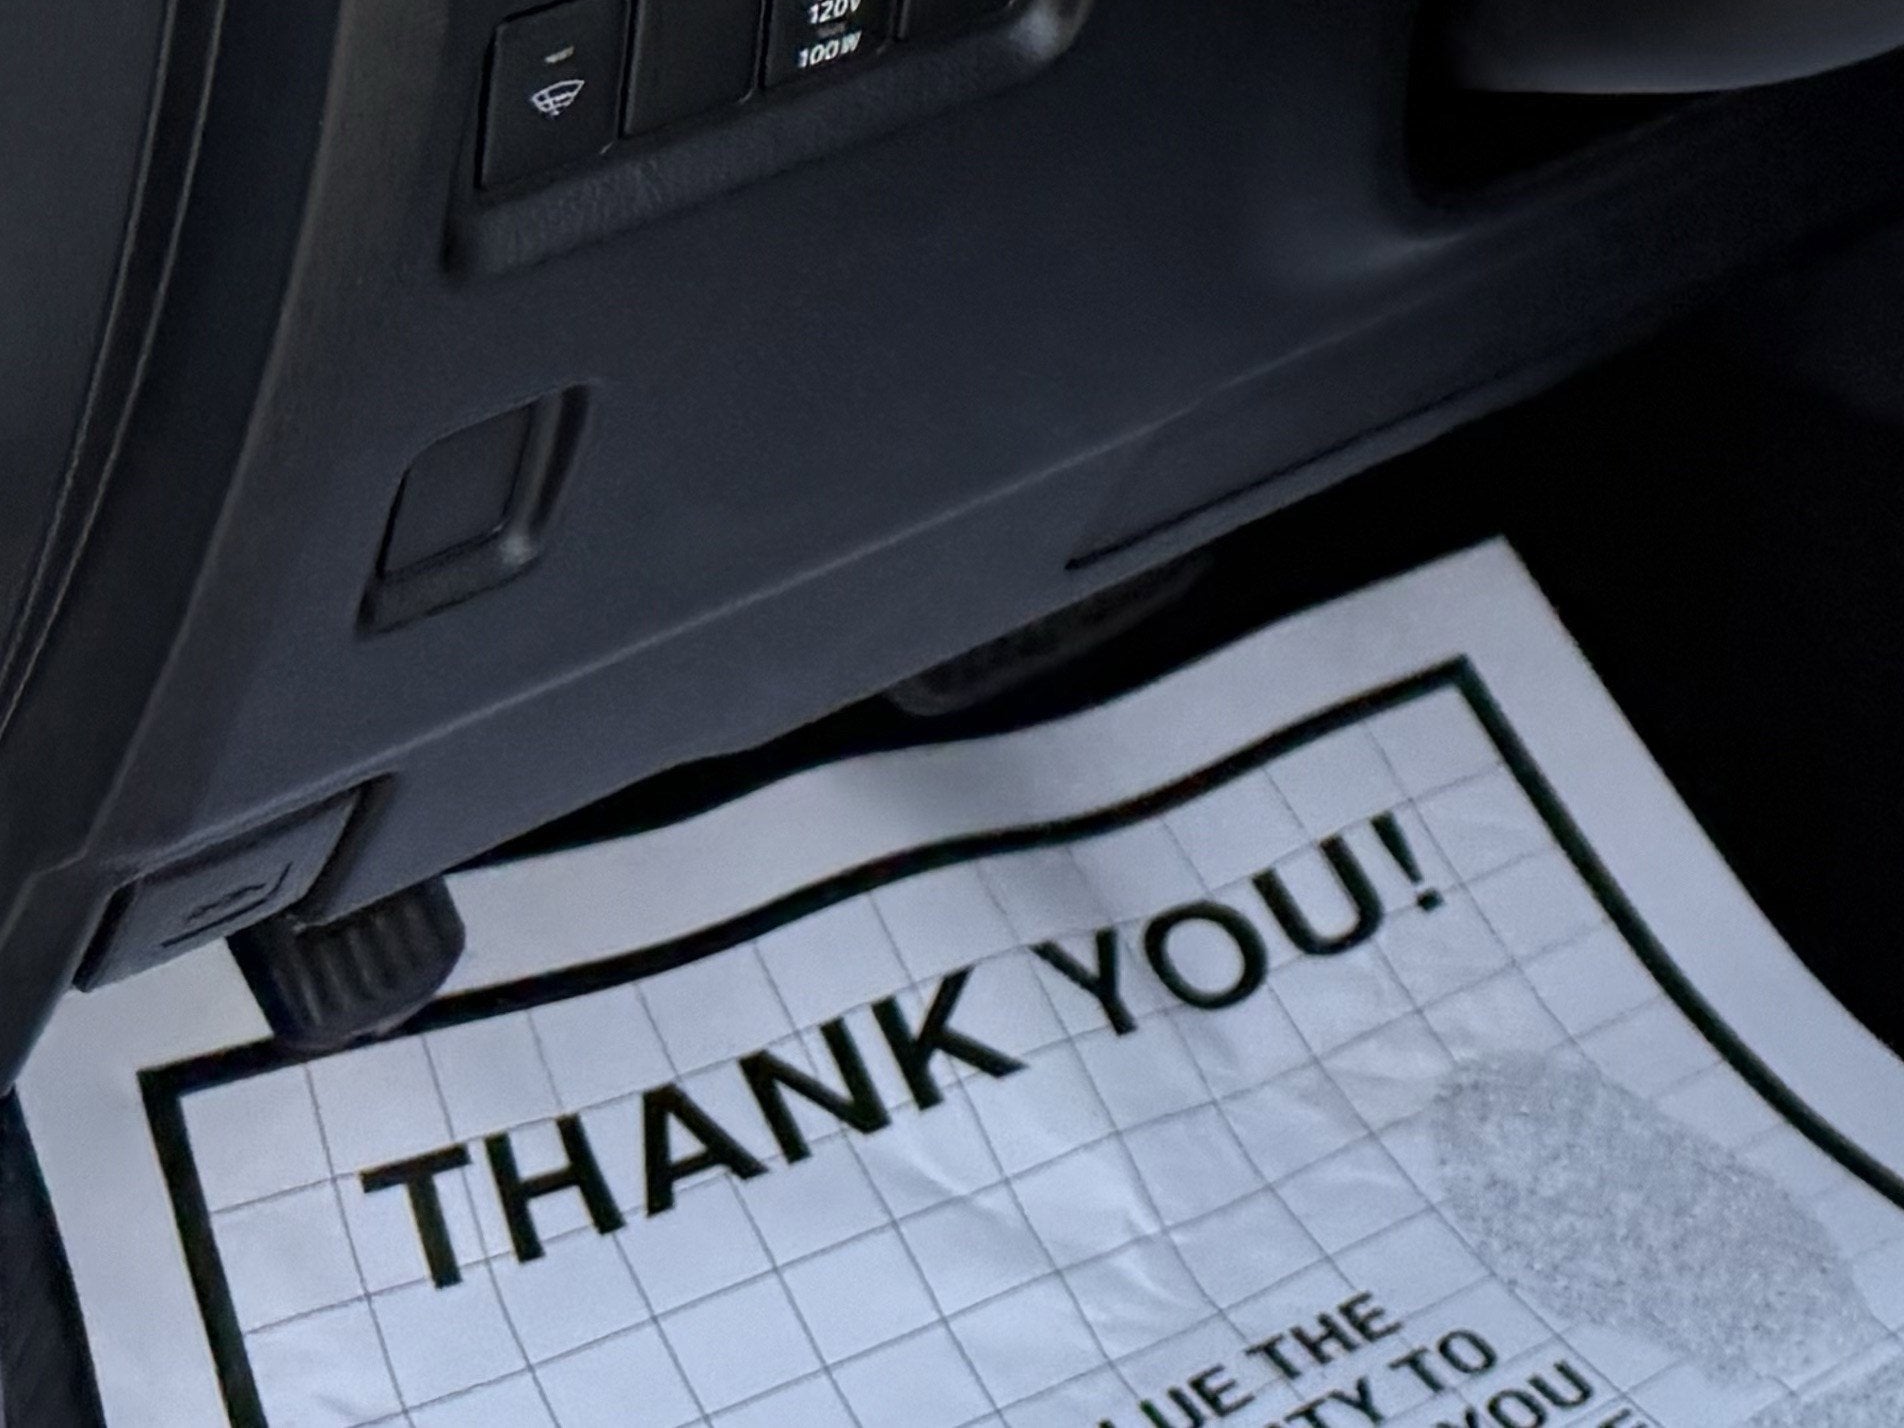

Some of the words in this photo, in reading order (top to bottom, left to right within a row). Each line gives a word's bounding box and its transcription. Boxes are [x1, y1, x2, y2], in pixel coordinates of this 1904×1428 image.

[797, 29, 863, 69] 100W
[360, 966, 1031, 1291] THANK
[1033, 809, 1446, 1037] YOU!
[1098, 1364, 1256, 1428] UE
[1245, 1291, 1402, 1380] THE
[1264, 1376, 1385, 1428] TY
[1389, 1328, 1498, 1394] TO
